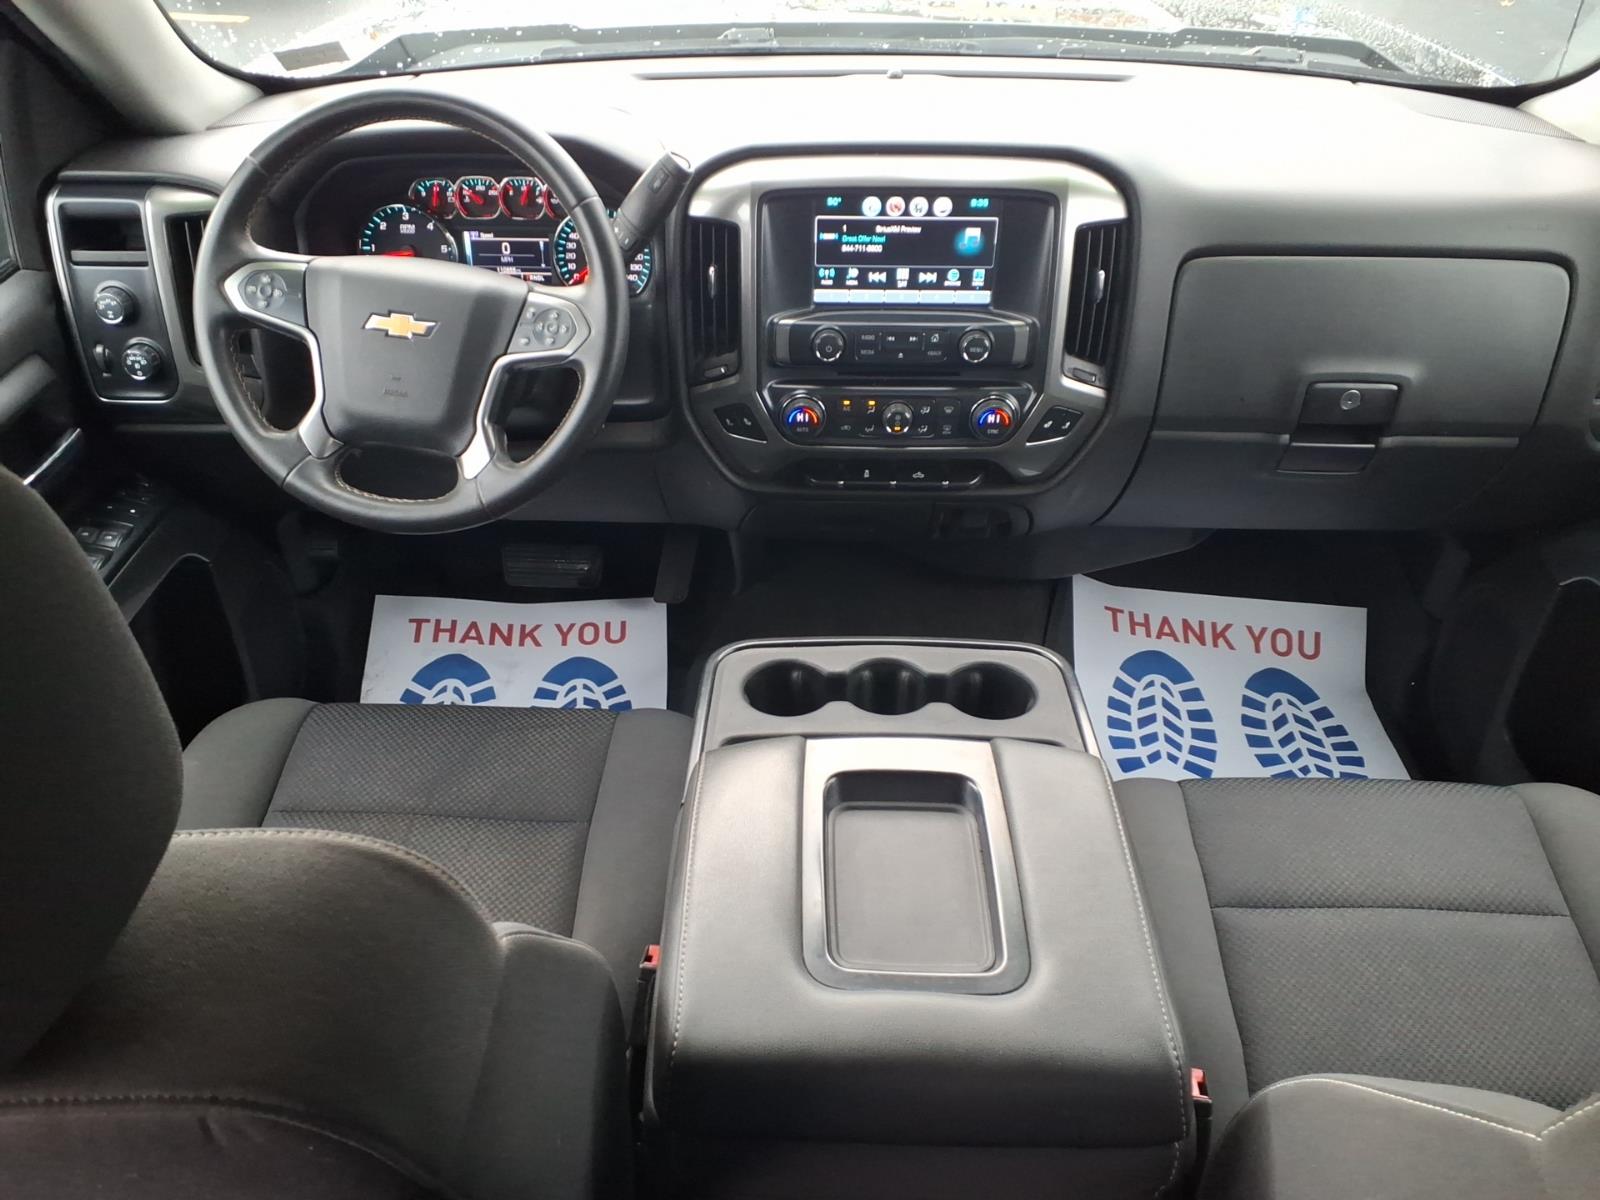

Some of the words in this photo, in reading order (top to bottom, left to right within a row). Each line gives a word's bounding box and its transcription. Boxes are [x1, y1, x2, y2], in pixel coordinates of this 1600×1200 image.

[402, 211, 409, 220] 3
[379, 222, 387, 230] 2
[427, 222, 434, 231] 4
[501, 242, 511, 255] 0
[566, 242, 577, 250] 30
[796, 412, 809, 423] HI
[987, 414, 1000, 424] HI
[409, 618, 543, 648] THANK
[554, 620, 628, 647] YOU
[1104, 605, 1237, 651] THANK
[1245, 624, 1322, 660] YOU
